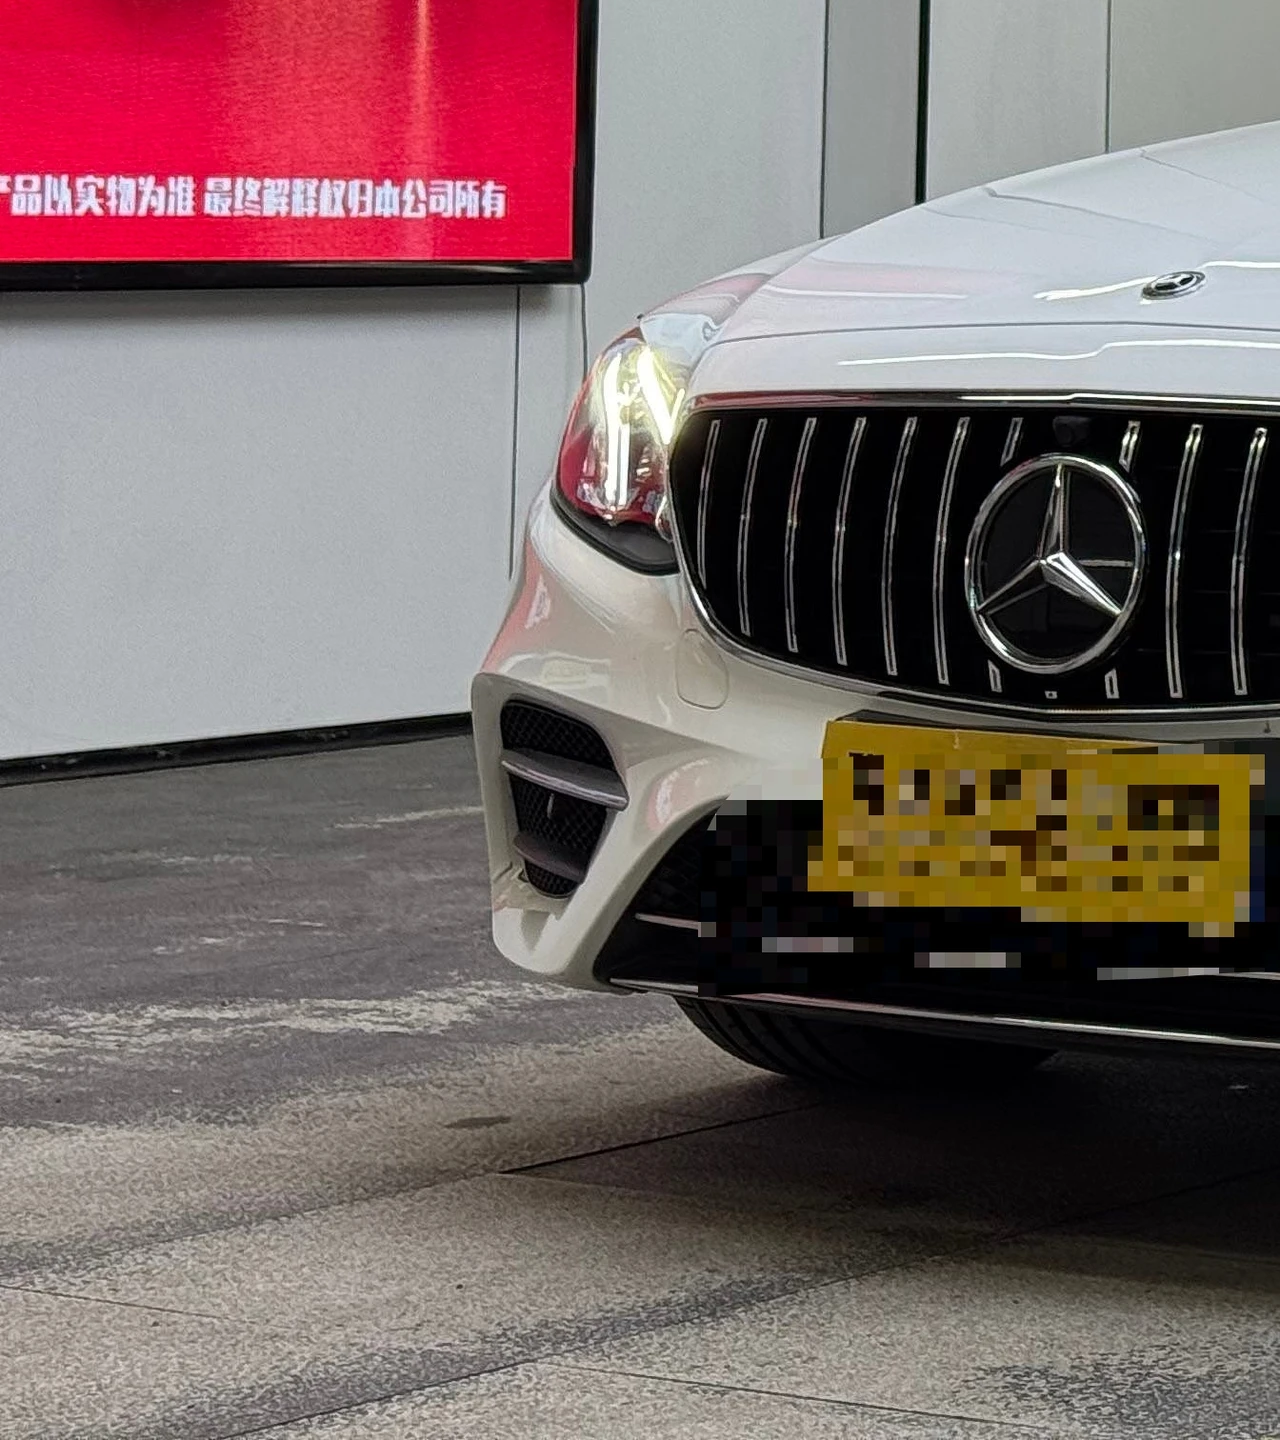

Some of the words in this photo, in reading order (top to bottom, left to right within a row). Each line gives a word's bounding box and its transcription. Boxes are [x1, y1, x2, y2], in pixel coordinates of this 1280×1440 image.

[203, 177, 507, 218] 最终解释权归本公司所有
